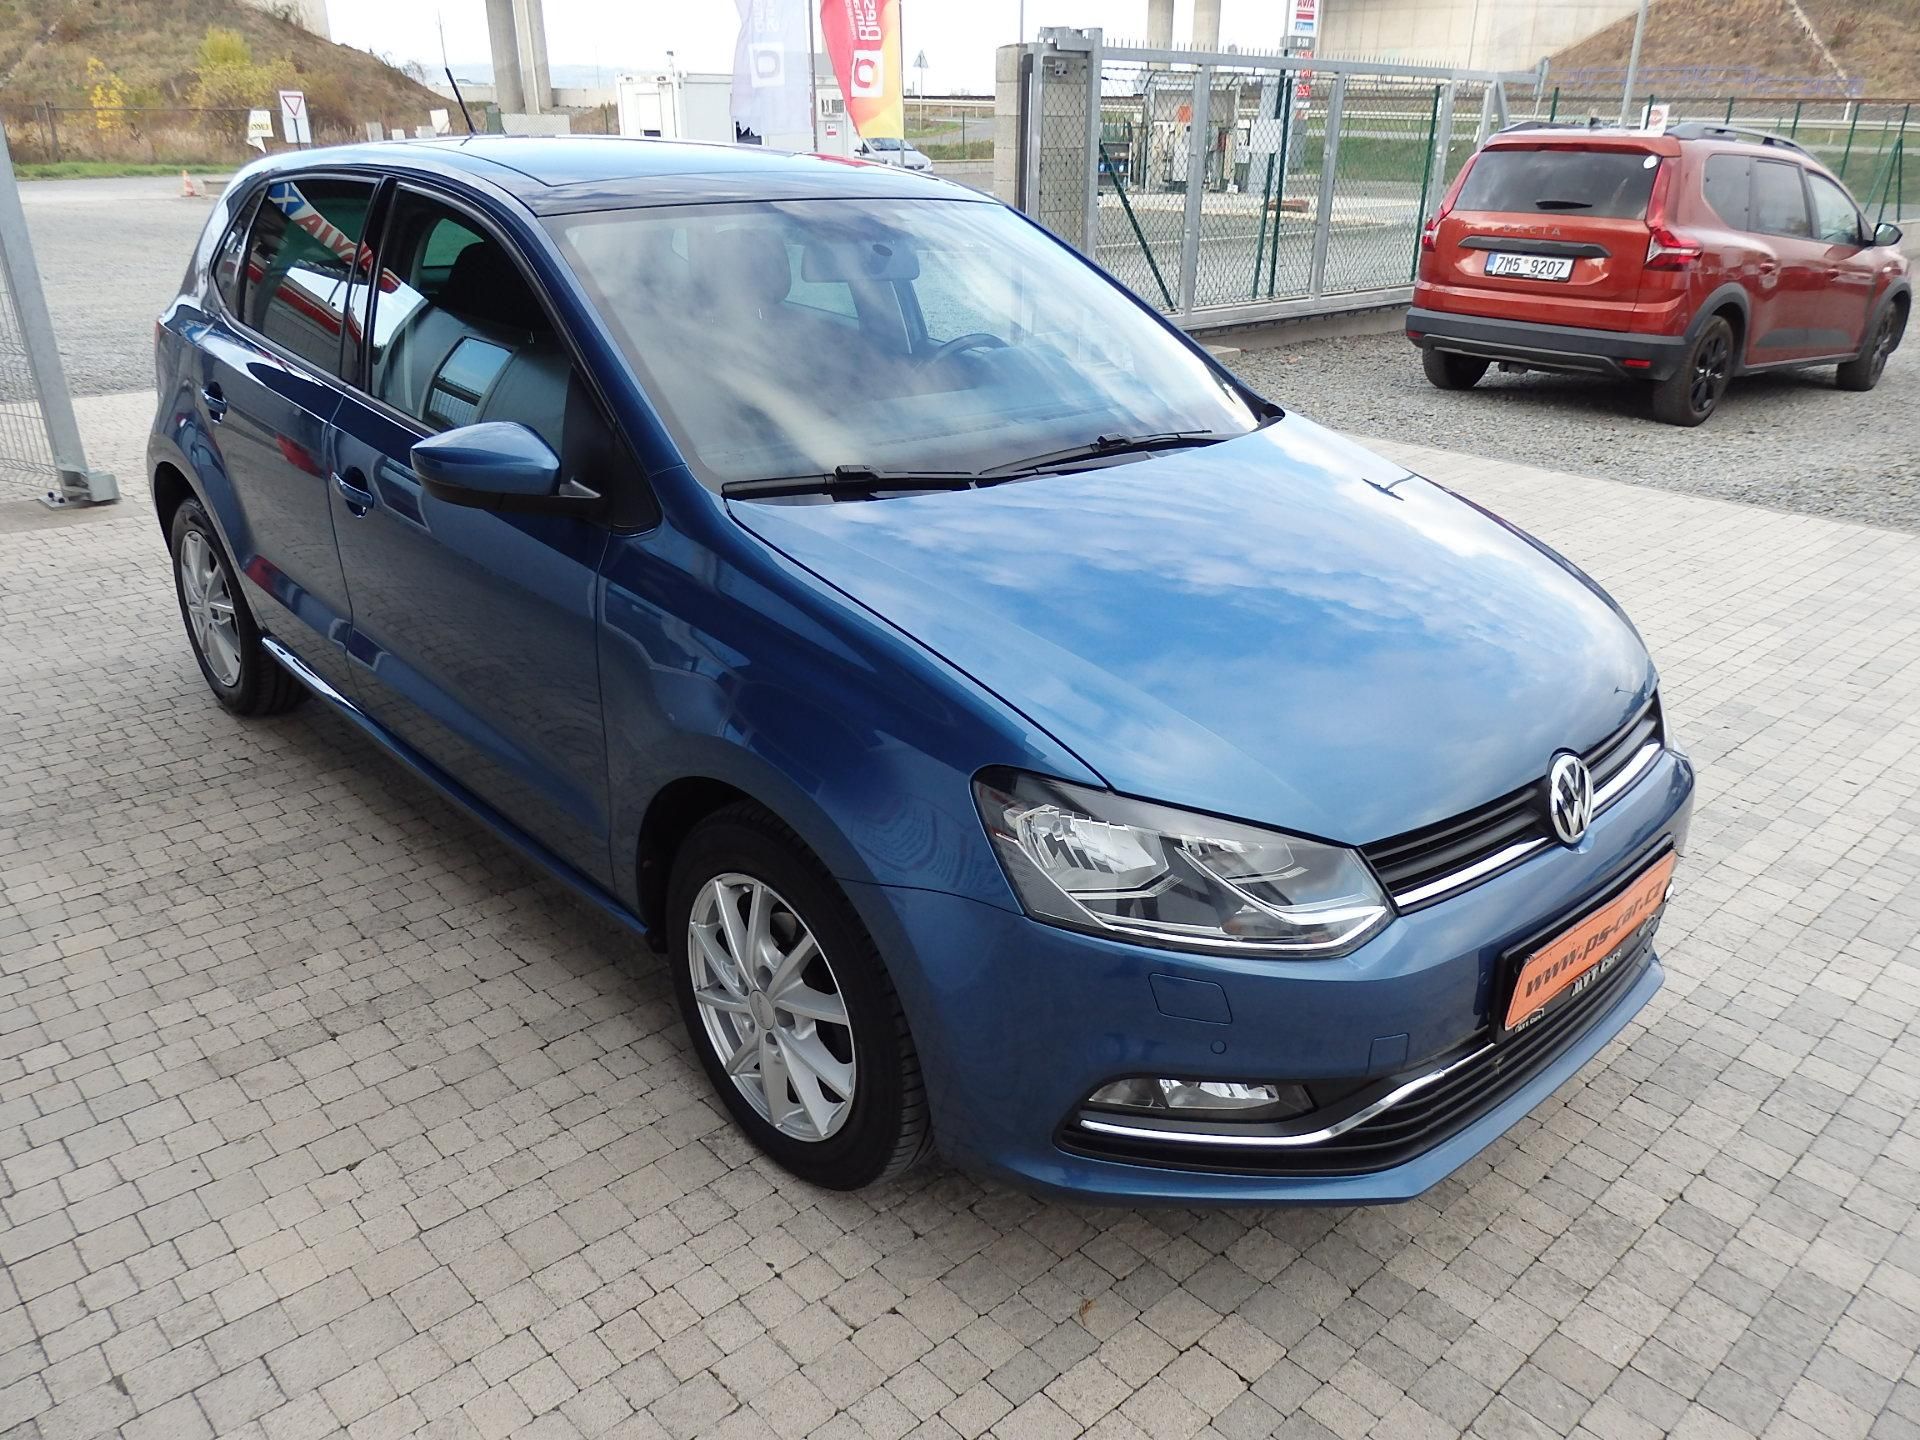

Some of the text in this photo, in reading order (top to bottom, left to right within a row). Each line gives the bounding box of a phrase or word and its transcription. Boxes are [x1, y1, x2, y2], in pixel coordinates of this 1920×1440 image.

[1503, 224, 1561, 236] DACIA
[1496, 256, 1565, 276] 7M5 9207
